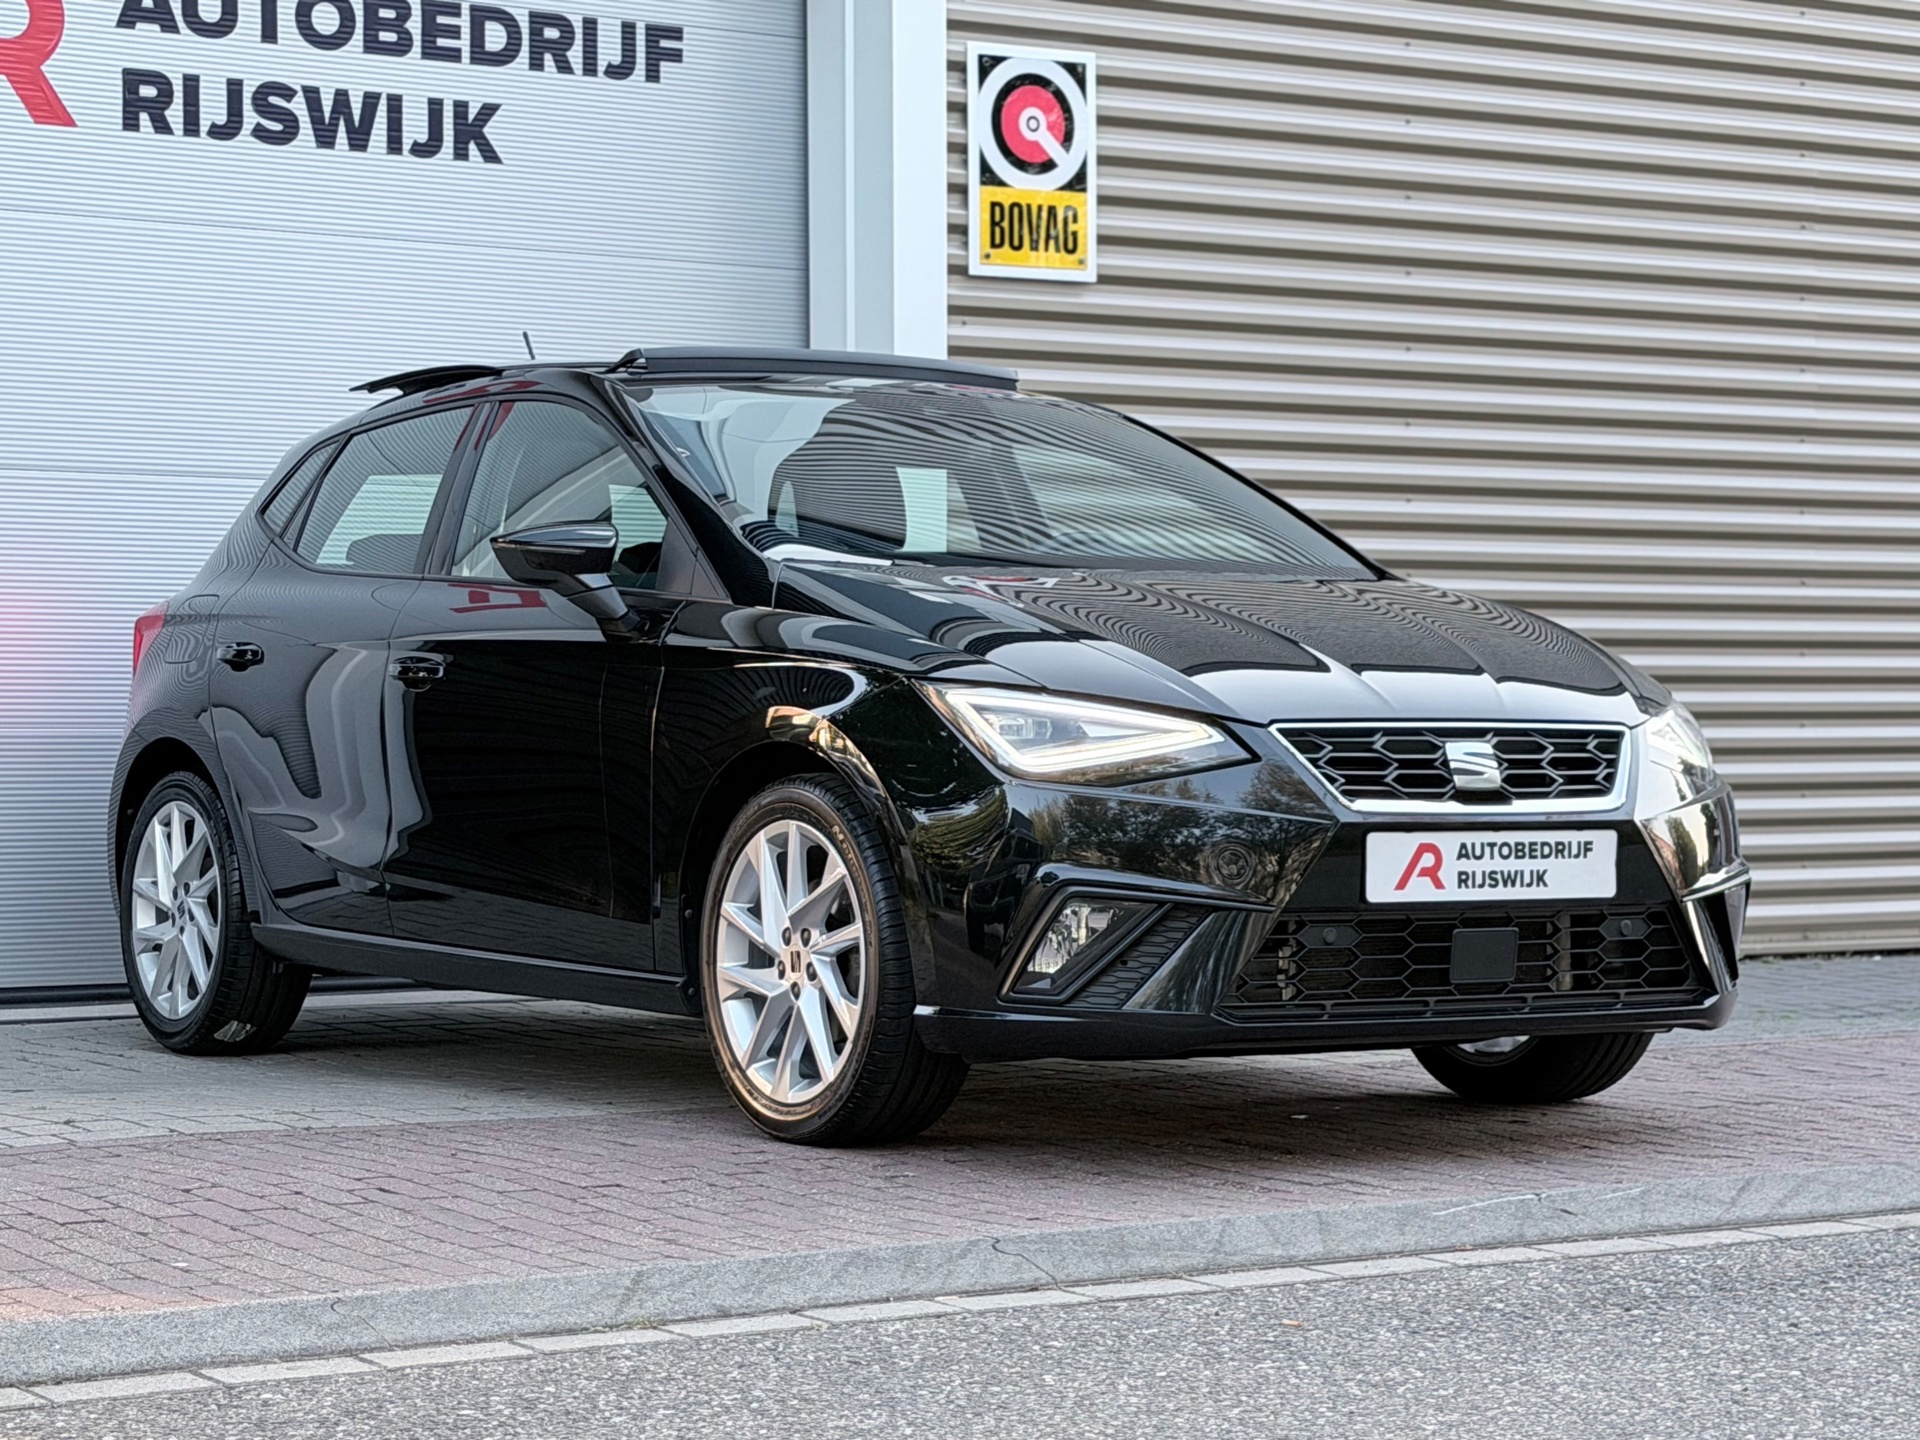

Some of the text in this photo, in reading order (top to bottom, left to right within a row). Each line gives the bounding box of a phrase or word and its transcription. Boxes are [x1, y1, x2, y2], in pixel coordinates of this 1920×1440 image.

[121, 67, 504, 165] RIJSWIJK
[989, 201, 1079, 255] BOVAG
[1456, 840, 1594, 861] AUTOBEDRIJF
[1457, 869, 1549, 889] RIJSWIJK
